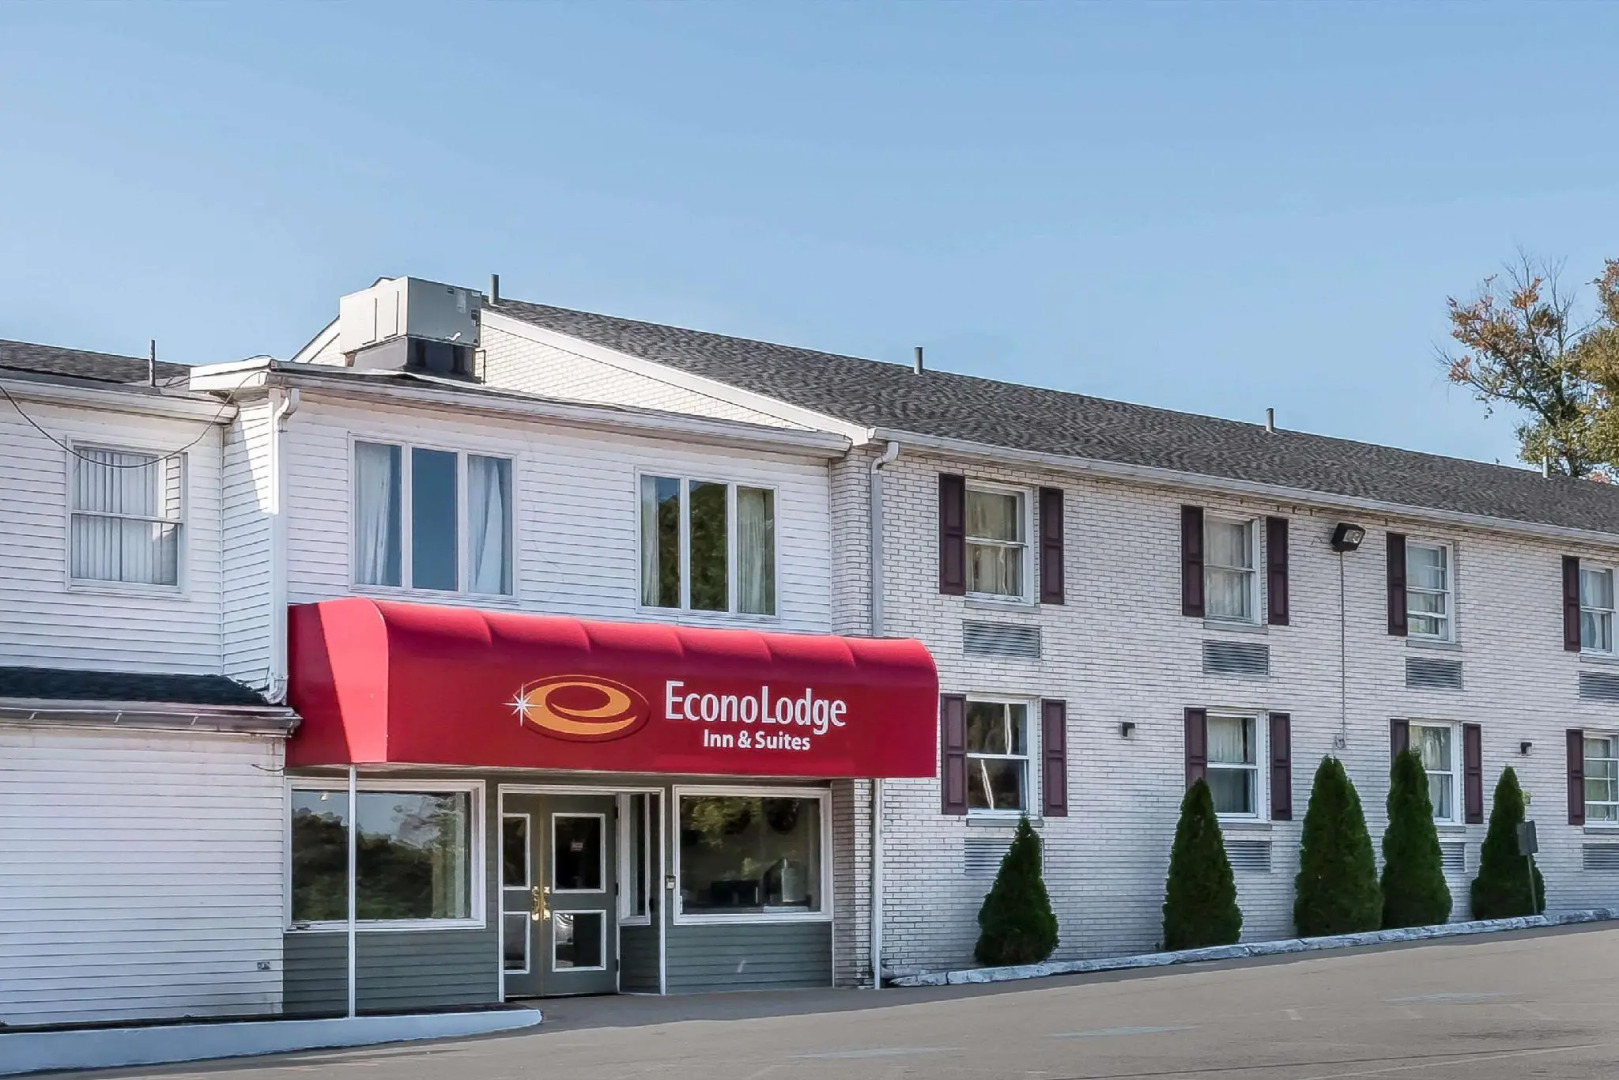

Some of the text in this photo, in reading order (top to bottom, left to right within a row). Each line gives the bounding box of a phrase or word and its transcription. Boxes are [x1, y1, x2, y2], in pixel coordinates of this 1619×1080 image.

[703, 729, 811, 751] Inn & Suites
